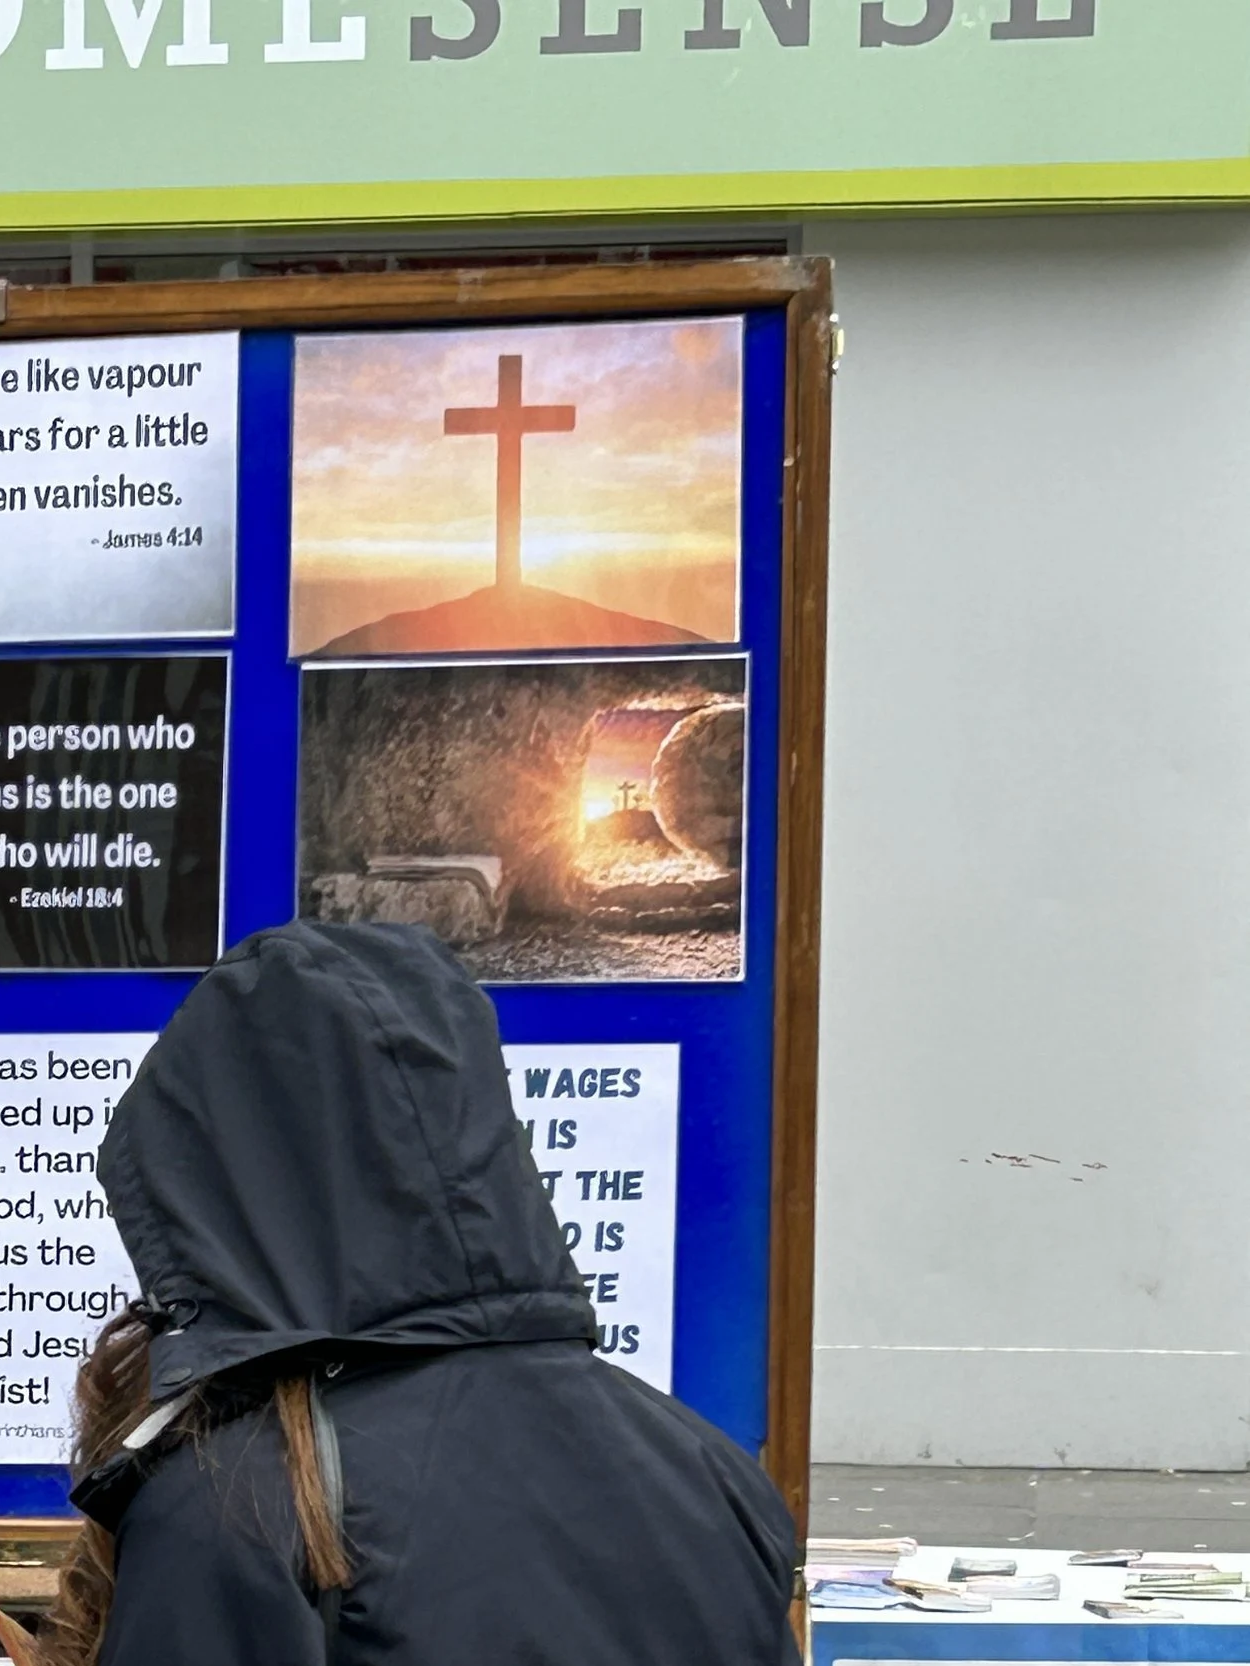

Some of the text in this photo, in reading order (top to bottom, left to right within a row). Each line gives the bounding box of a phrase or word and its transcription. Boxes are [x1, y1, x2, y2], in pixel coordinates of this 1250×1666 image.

[27, 358, 80, 392] like
[88, 360, 202, 398] vapour
[49, 416, 100, 451] for
[108, 423, 129, 449] a
[135, 412, 209, 448] little
[33, 473, 183, 510] vanishes.
[102, 528, 162, 549] James
[166, 526, 203, 547] 4:14
[7, 721, 120, 759] person
[127, 714, 196, 750] who
[26, 774, 51, 809] is
[58, 774, 113, 809] the
[118, 781, 178, 809] one
[44, 833, 98, 868] will
[103, 833, 161, 868] die.
[20, 887, 82, 908] Ezekiel
[85, 887, 124, 908] 18:4
[48, 1050, 132, 1081] been
[524, 1068, 641, 1098] WAGES
[53, 1105, 94, 1134] up
[547, 1119, 577, 1150] IS
[15, 1144, 96, 1173] than
[576, 1171, 644, 1200] THE
[37, 1236, 95, 1266] the
[595, 1221, 625, 1252] IS
[22, 1337, 90, 1359] Jesu
